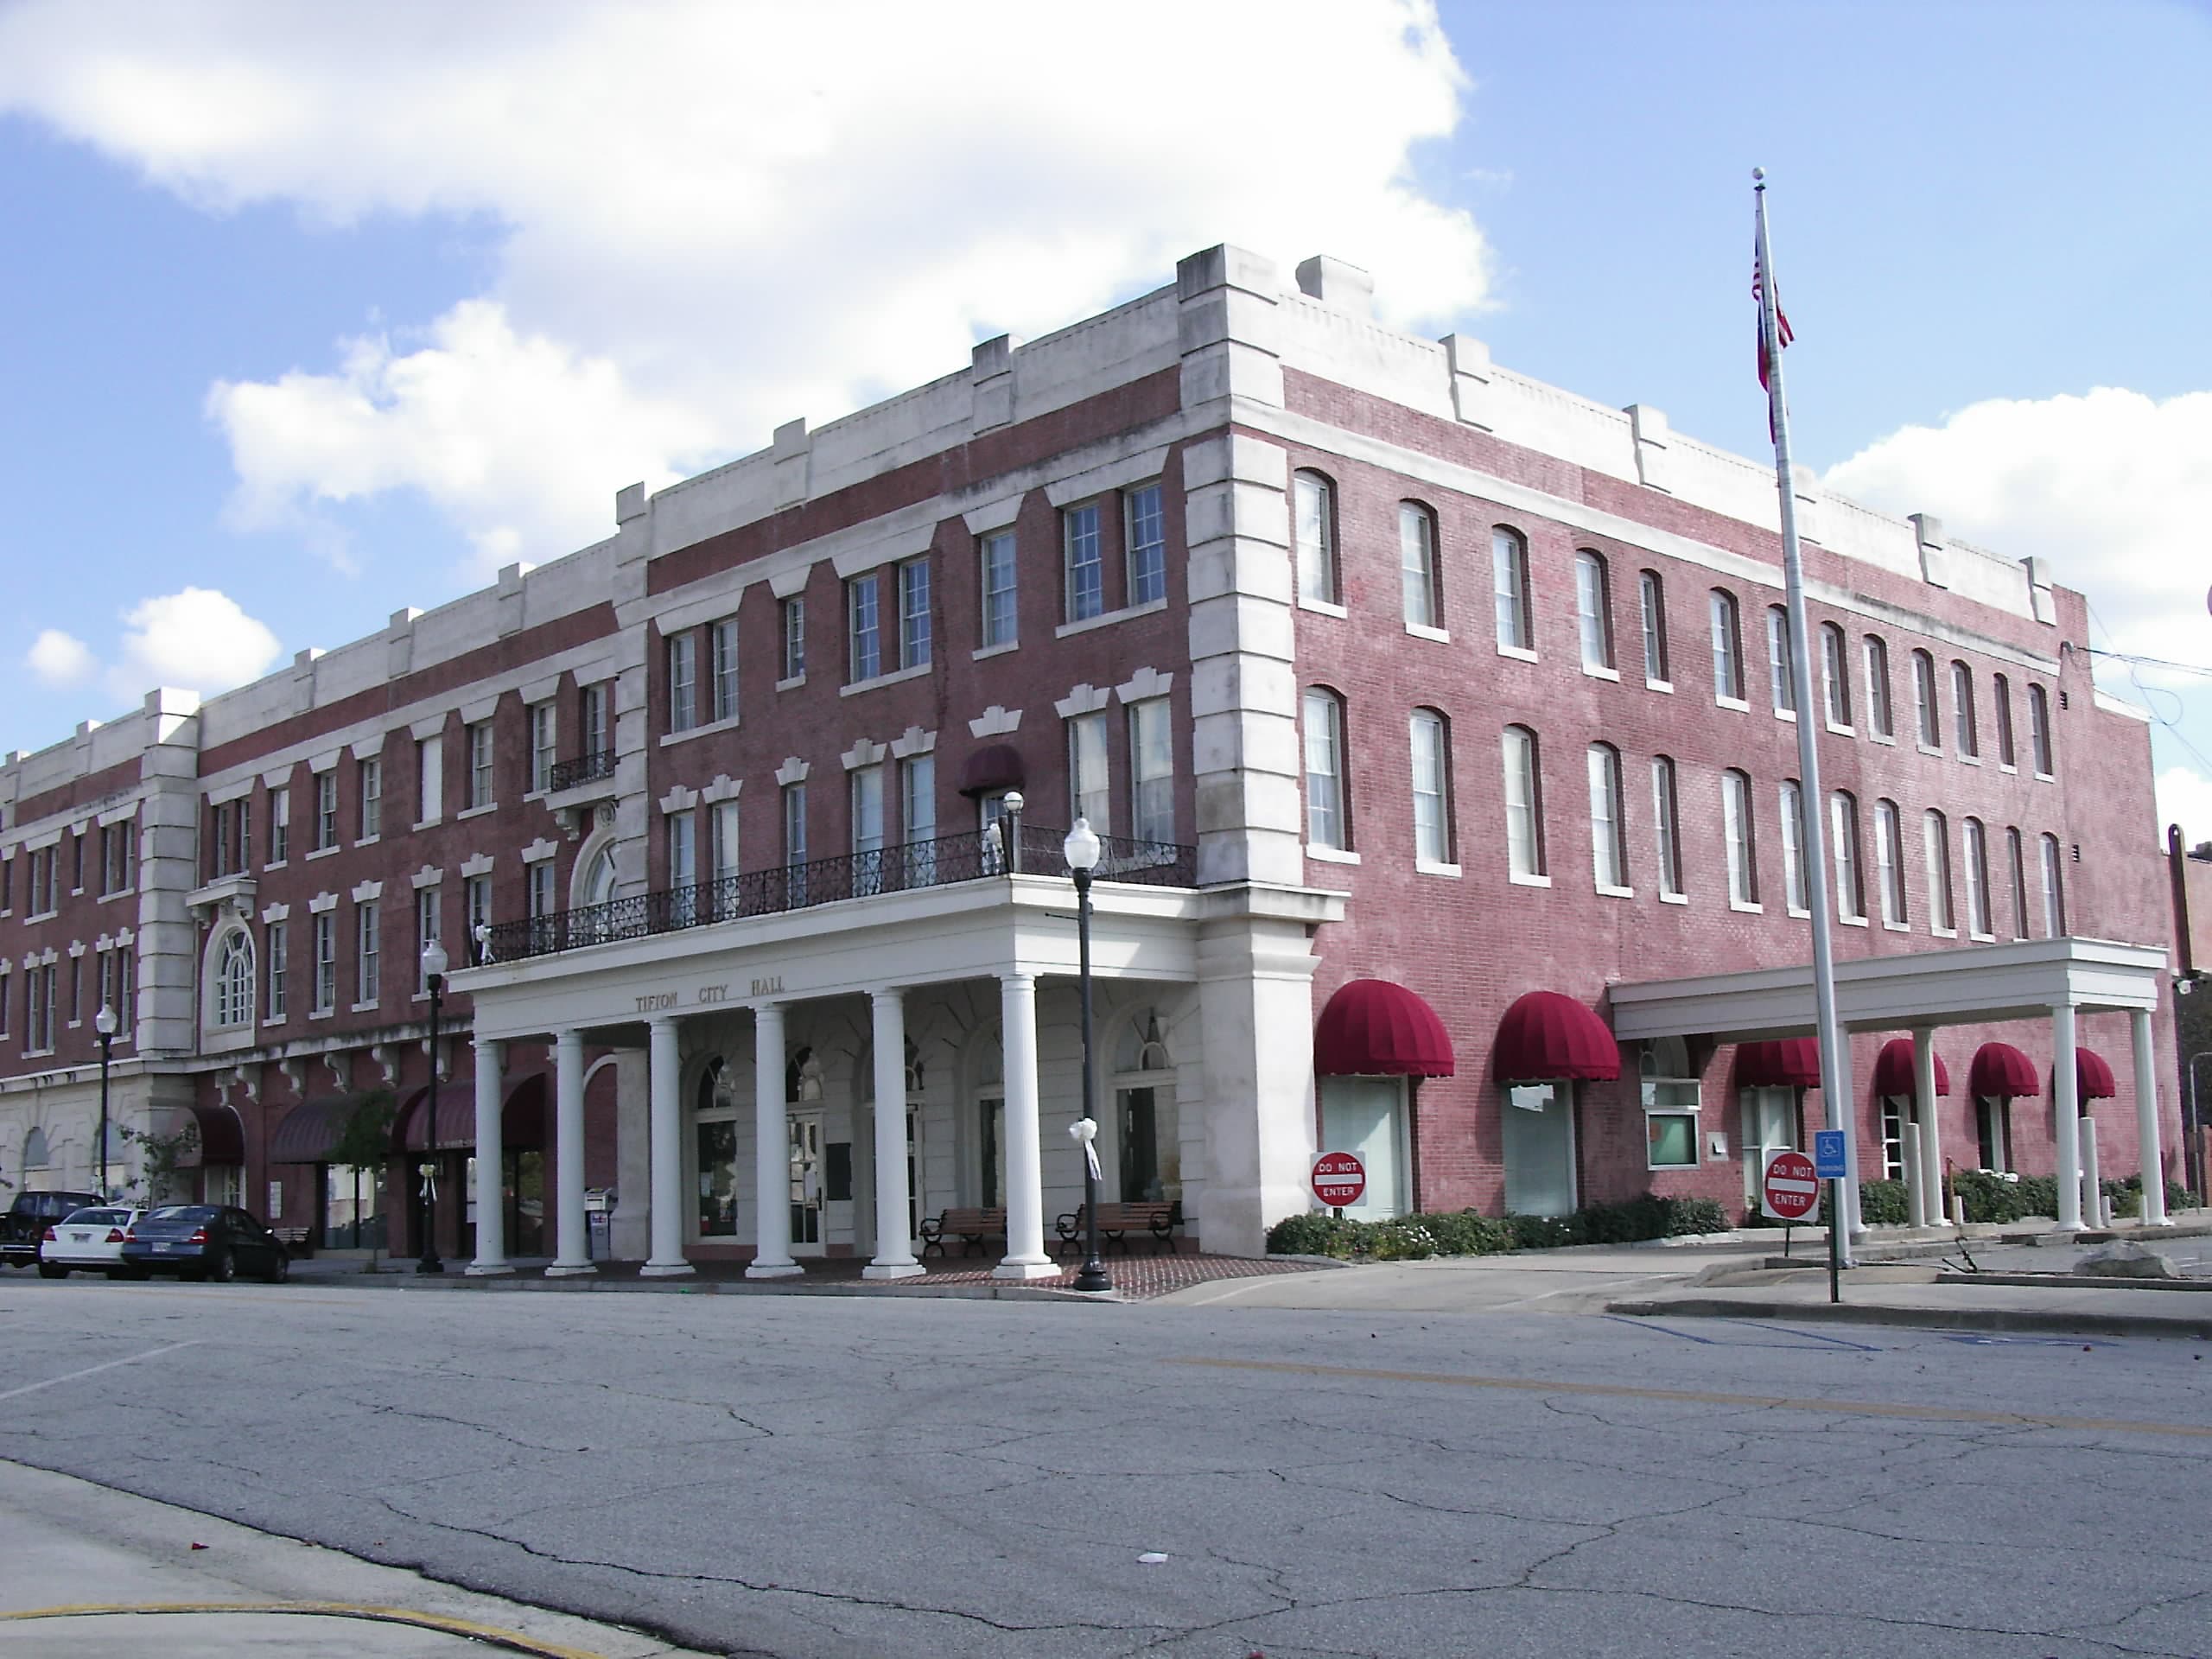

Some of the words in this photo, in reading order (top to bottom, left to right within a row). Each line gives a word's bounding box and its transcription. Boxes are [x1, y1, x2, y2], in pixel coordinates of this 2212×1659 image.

[636, 992, 677, 1012] TIFTON
[698, 984, 729, 1003] CITY
[751, 976, 785, 996] HALL
[1319, 1163, 1332, 1172] DO
[1338, 1162, 1357, 1172] NOT
[1773, 1164, 1787, 1175] DO
[1793, 1166, 1812, 1178] NOT
[1323, 1186, 1355, 1197] ENTER
[1775, 1193, 1806, 1206] ENTER
